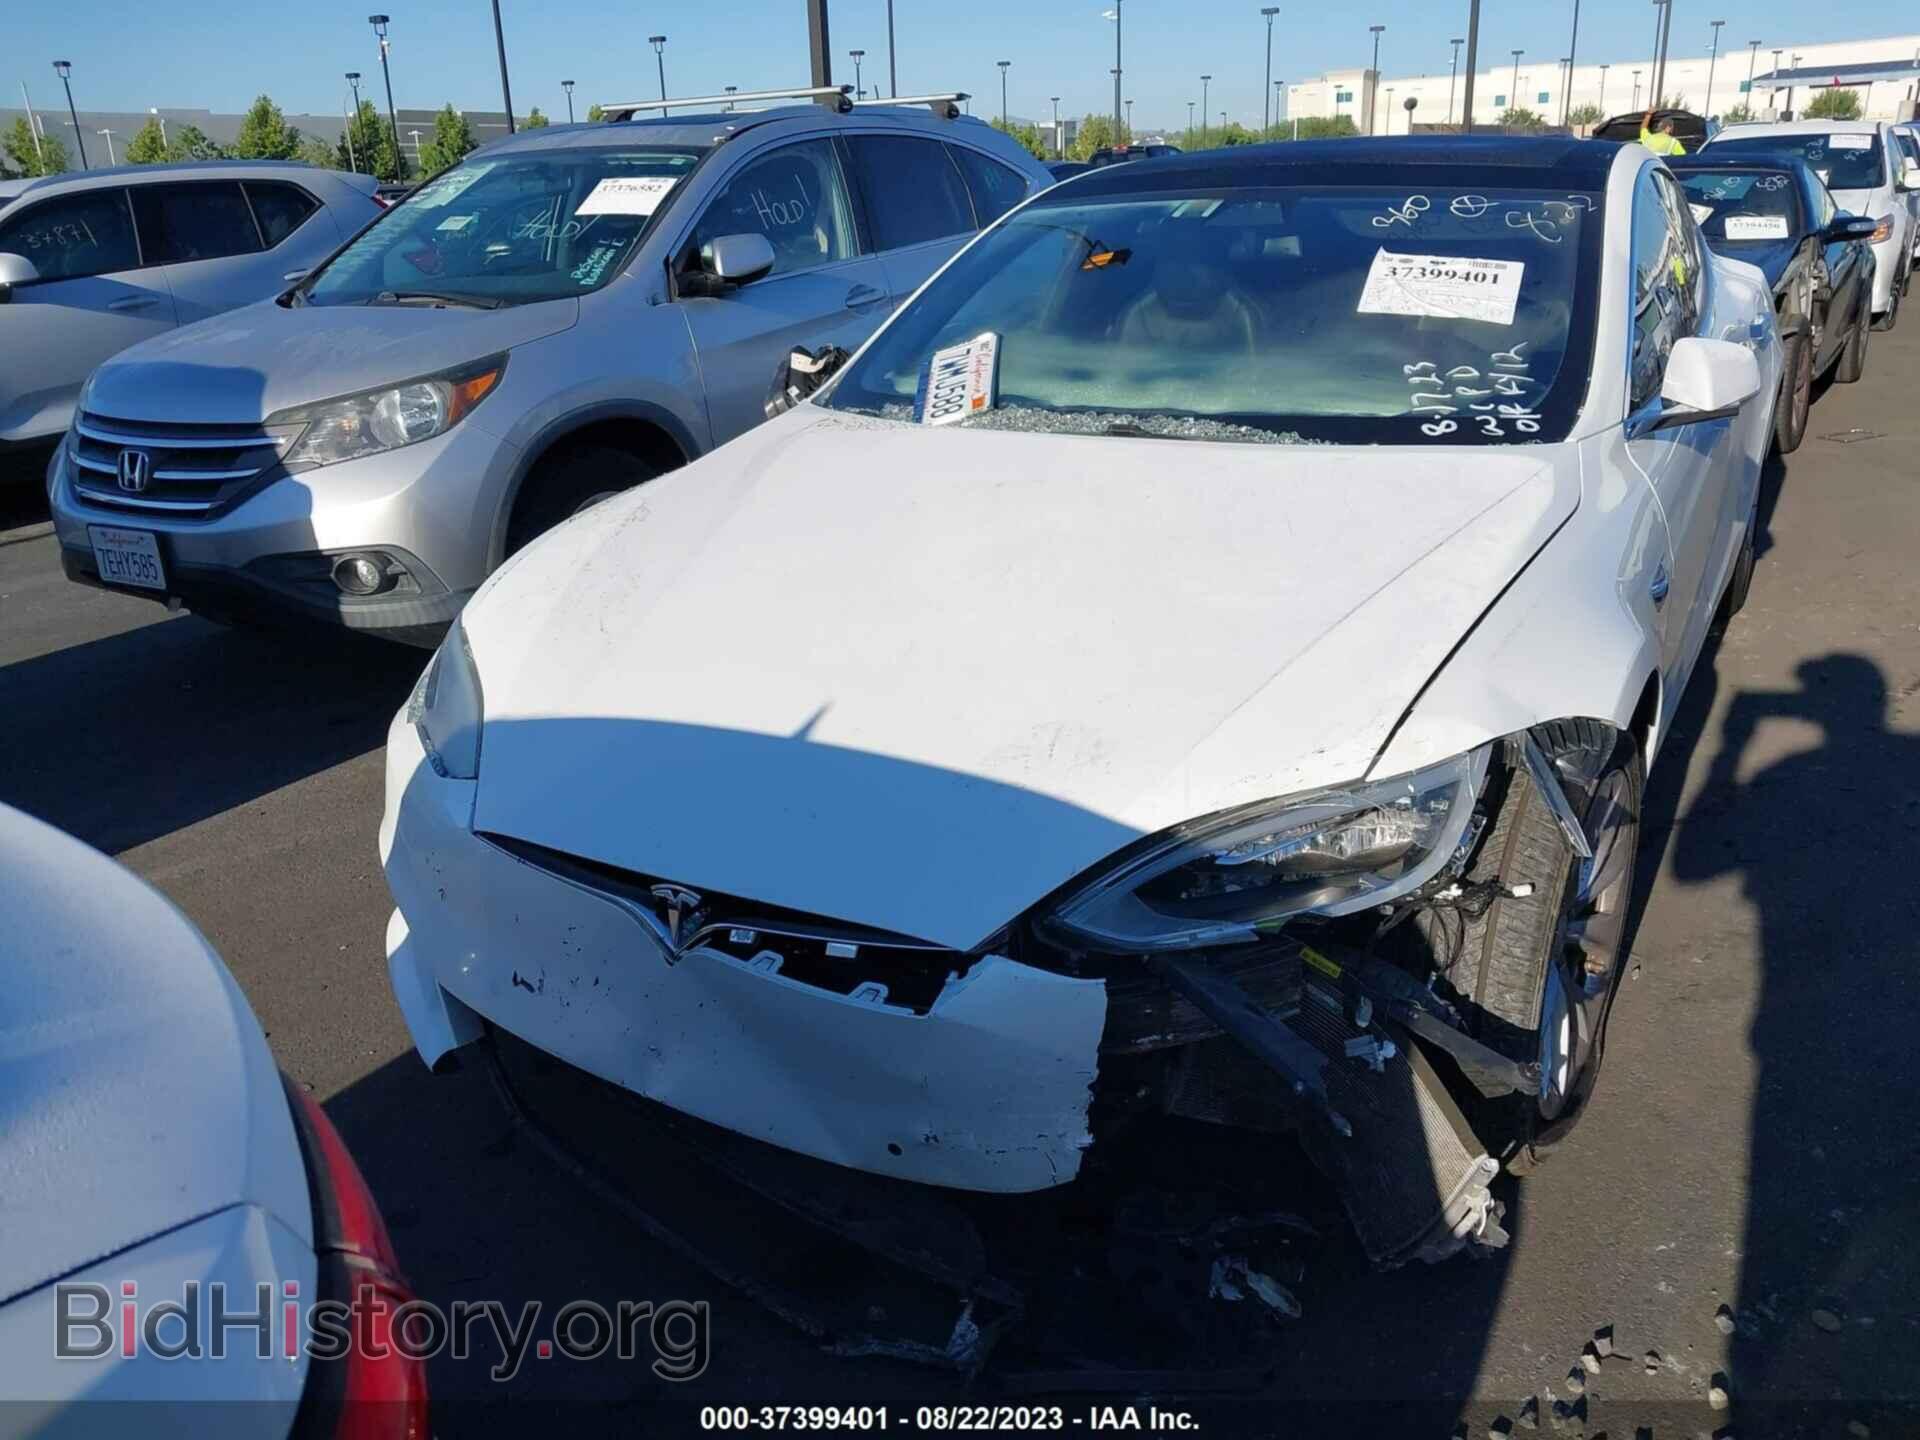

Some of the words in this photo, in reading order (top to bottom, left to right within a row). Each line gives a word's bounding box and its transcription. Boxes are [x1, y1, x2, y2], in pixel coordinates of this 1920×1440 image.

[1384, 266, 1499, 285] 37399401
[931, 348, 971, 418] 7WMJ588
[98, 548, 159, 582] 7EHY585
